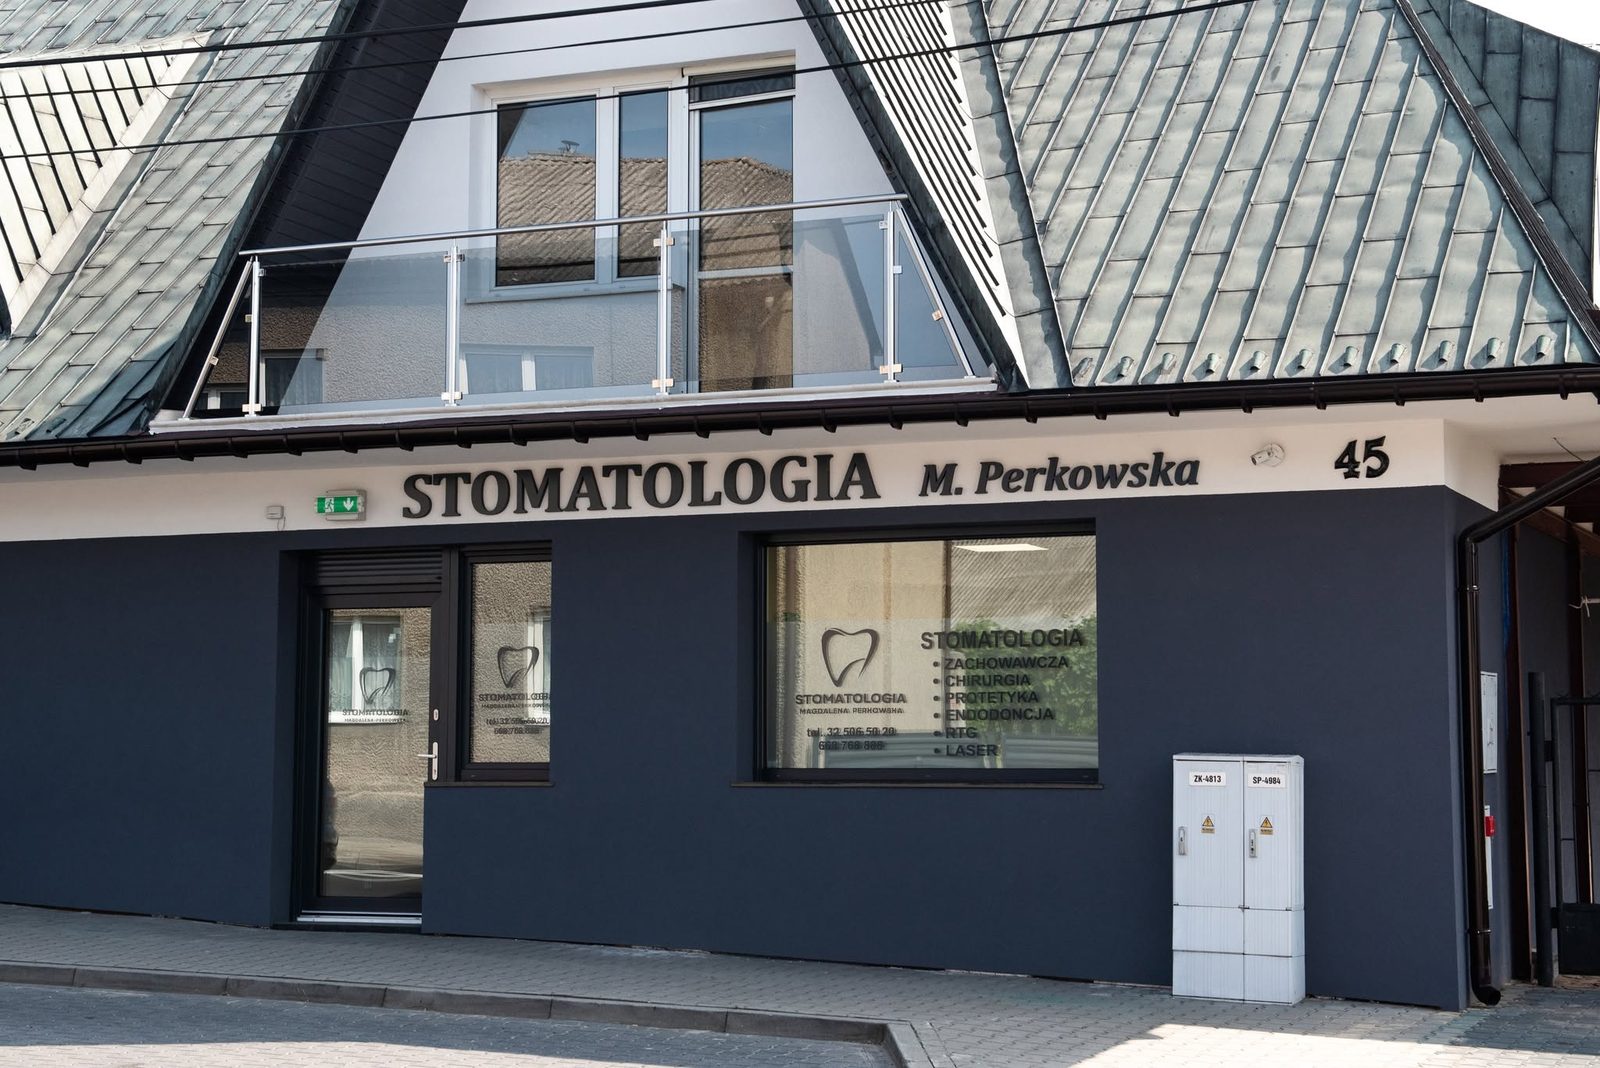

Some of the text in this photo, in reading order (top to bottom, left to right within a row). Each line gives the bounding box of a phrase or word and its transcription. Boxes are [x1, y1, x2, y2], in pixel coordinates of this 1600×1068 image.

[1334, 435, 1391, 480] 45
[918, 451, 1200, 497] M. Perkowska
[402, 452, 881, 519] STOMATOLOGIA
[921, 628, 1084, 650] STOMATOLOGIA
[944, 656, 1069, 670] ZACHOWAWCZA
[945, 674, 1031, 687] CHIRURGIA
[795, 693, 907, 705] STOMATOLOGIA
[945, 691, 1039, 704] PROTETYKA
[945, 708, 1055, 721] ENDODONCJA
[945, 726, 978, 739] RTG
[945, 744, 998, 757] LASER
[1194, 775, 1222, 783] ZK-4813
[1252, 776, 1281, 785] SP-4984
